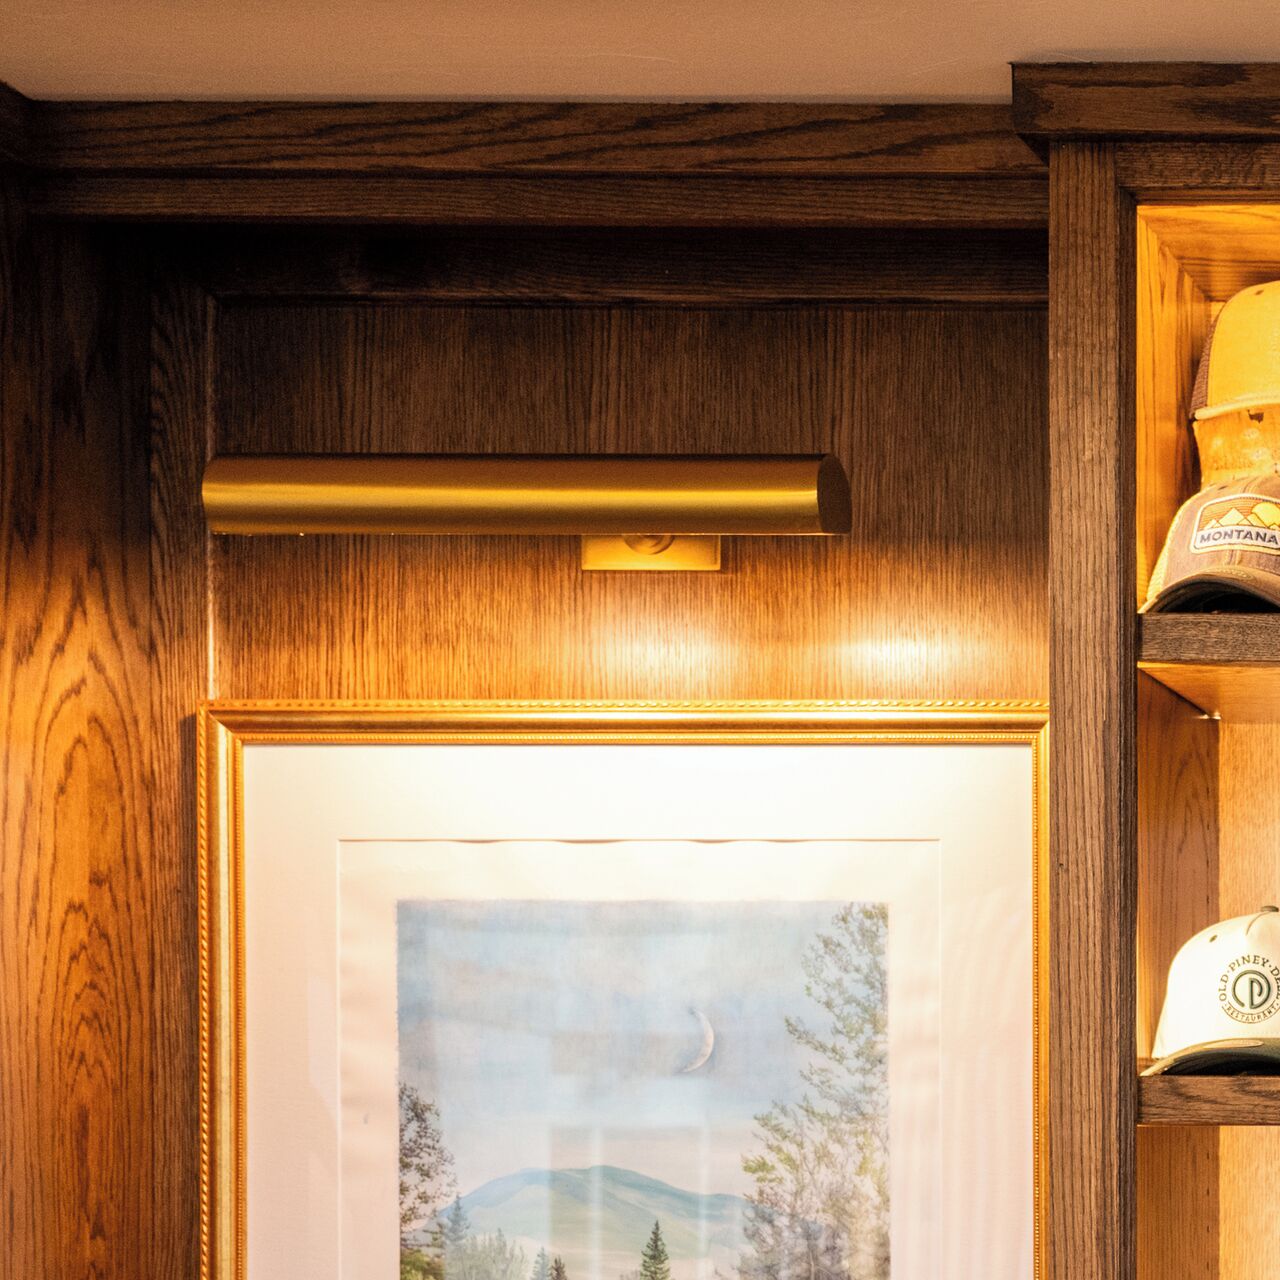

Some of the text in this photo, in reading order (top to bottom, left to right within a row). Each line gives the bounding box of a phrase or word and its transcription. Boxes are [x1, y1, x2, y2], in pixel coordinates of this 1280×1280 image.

[1199, 529, 1279, 545] MONTANA
[1219, 974, 1229, 1002] OLD
[1228, 955, 1268, 971] PINEY
